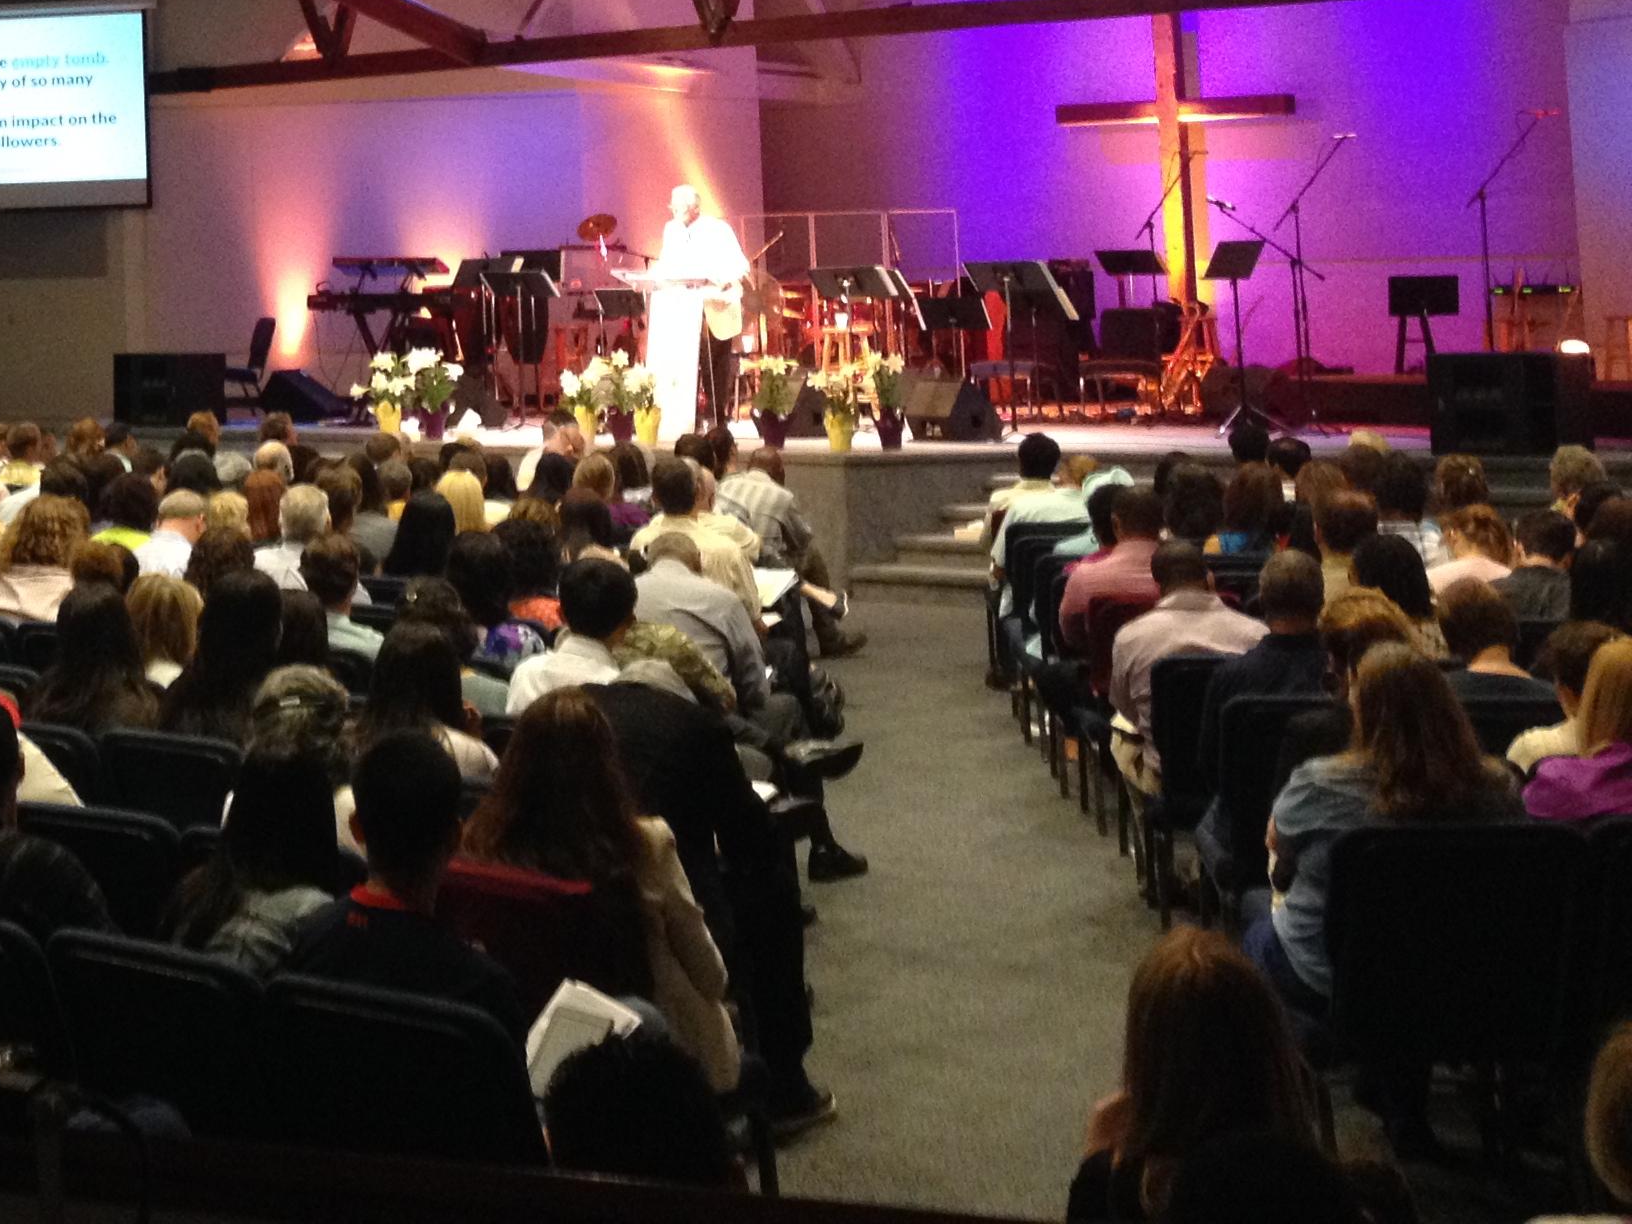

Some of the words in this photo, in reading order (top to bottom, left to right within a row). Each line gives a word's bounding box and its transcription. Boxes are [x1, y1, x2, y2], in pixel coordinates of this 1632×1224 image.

[11, 55, 60, 71] empty
[11, 74, 27, 87] of
[30, 77, 48, 88] so
[51, 74, 94, 88] many
[11, 115, 63, 130] impact
[68, 115, 88, 127] on
[92, 111, 117, 125] the
